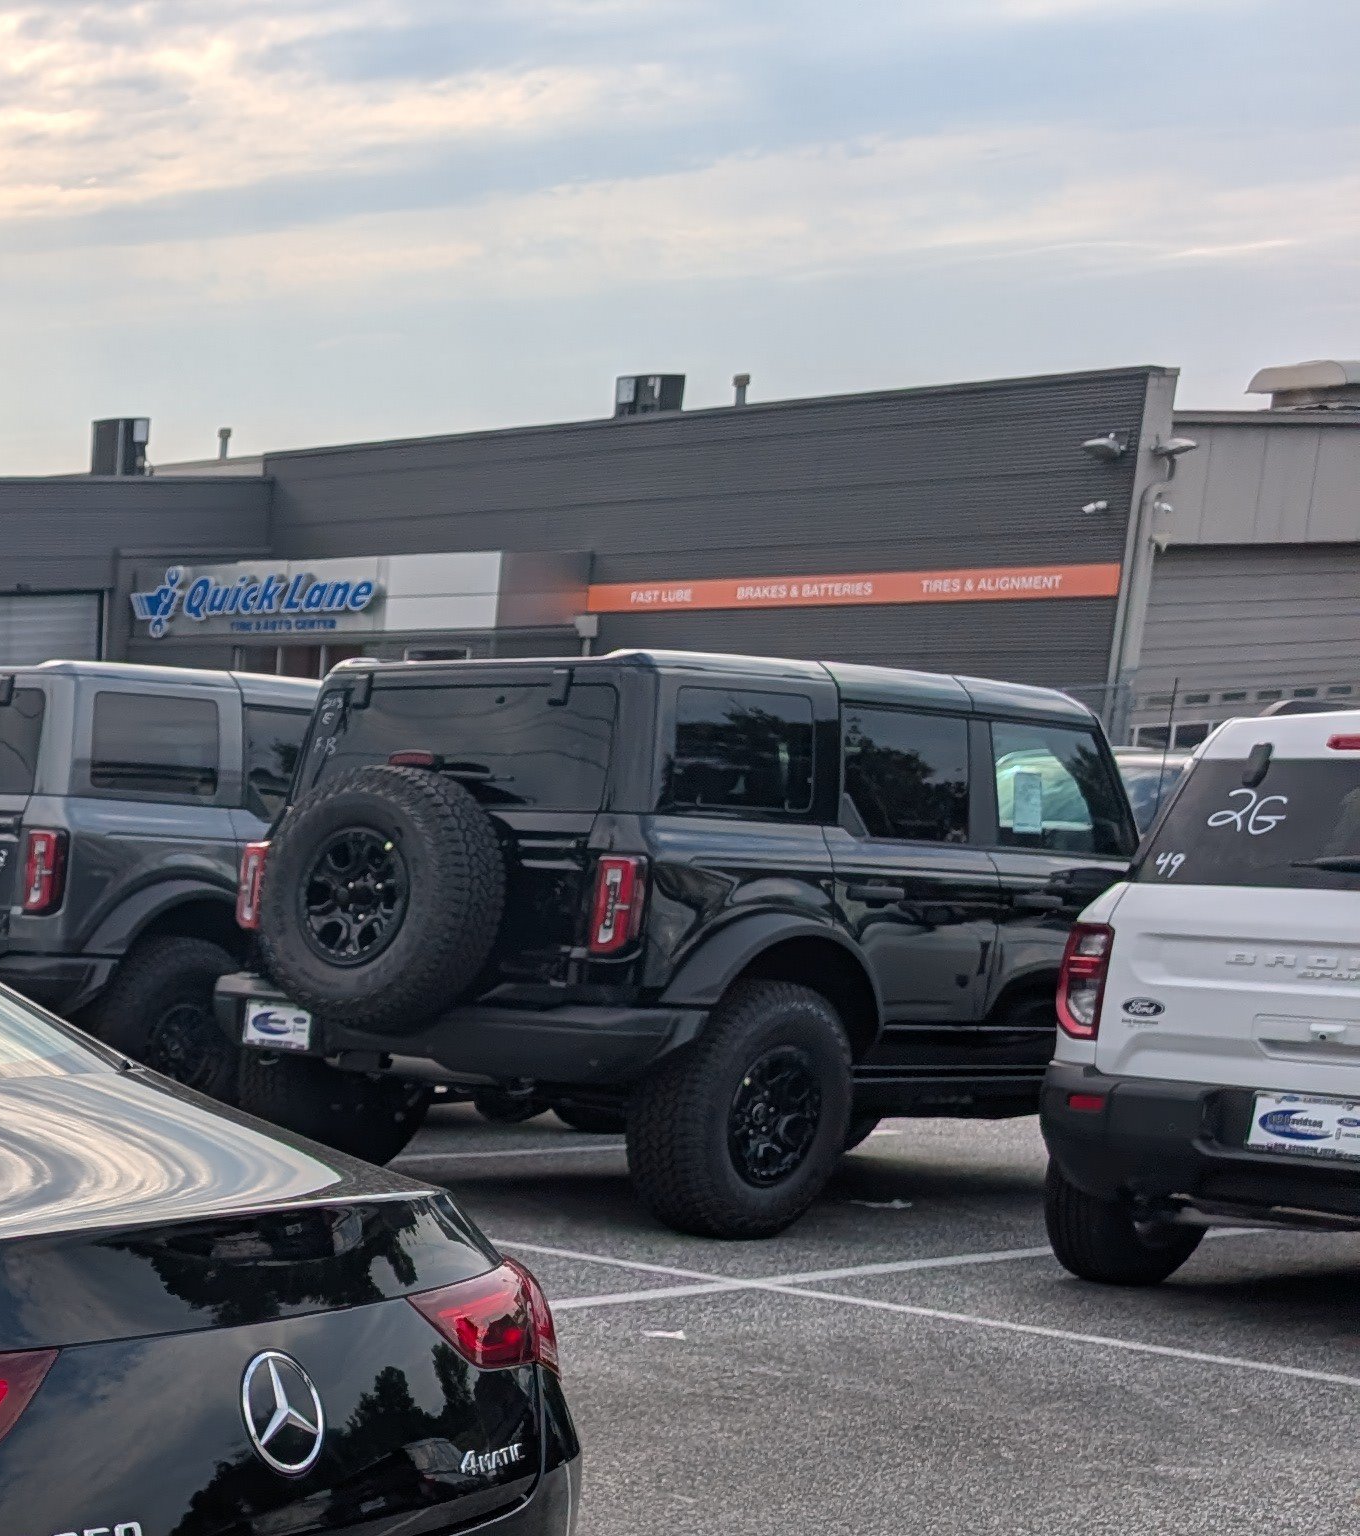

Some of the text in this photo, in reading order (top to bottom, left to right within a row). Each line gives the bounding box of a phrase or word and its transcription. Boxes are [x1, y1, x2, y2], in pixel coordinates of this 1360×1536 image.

[737, 581, 873, 600] BRAKES & BATTERIES
[921, 574, 1063, 593] TIRES & ALIGNMENT
[184, 572, 376, 621] Quick Lane
[631, 589, 692, 603] FAST LUBE
[1155, 852, 1186, 878] 49
[461, 1443, 526, 1475] 4MATIC
